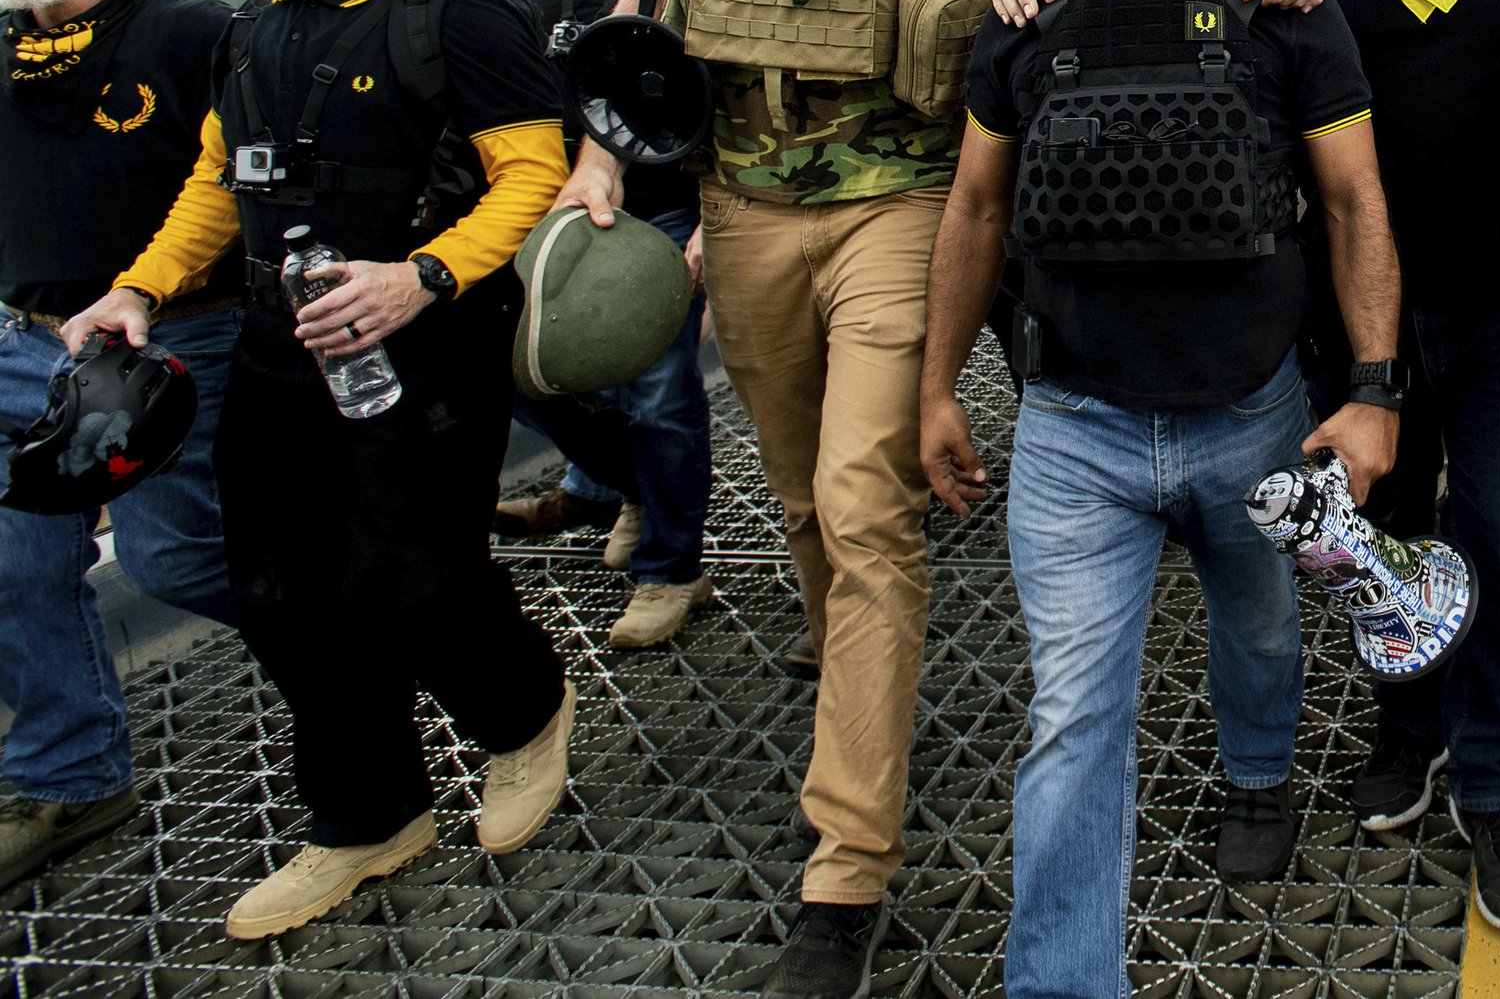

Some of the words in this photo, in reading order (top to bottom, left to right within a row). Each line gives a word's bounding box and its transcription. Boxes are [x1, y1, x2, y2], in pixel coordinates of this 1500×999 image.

[304, 279, 327, 294] LIFE
[1321, 514, 1345, 539] WATER
[1340, 531, 1357, 550] TAP
[1352, 542, 1369, 562] THE
[1365, 554, 1376, 567] IN
[1371, 560, 1395, 587] POISON
[1389, 579, 1401, 592] IS
[1397, 585, 1421, 611] THERE
[1369, 616, 1399, 630] LIBERTY
